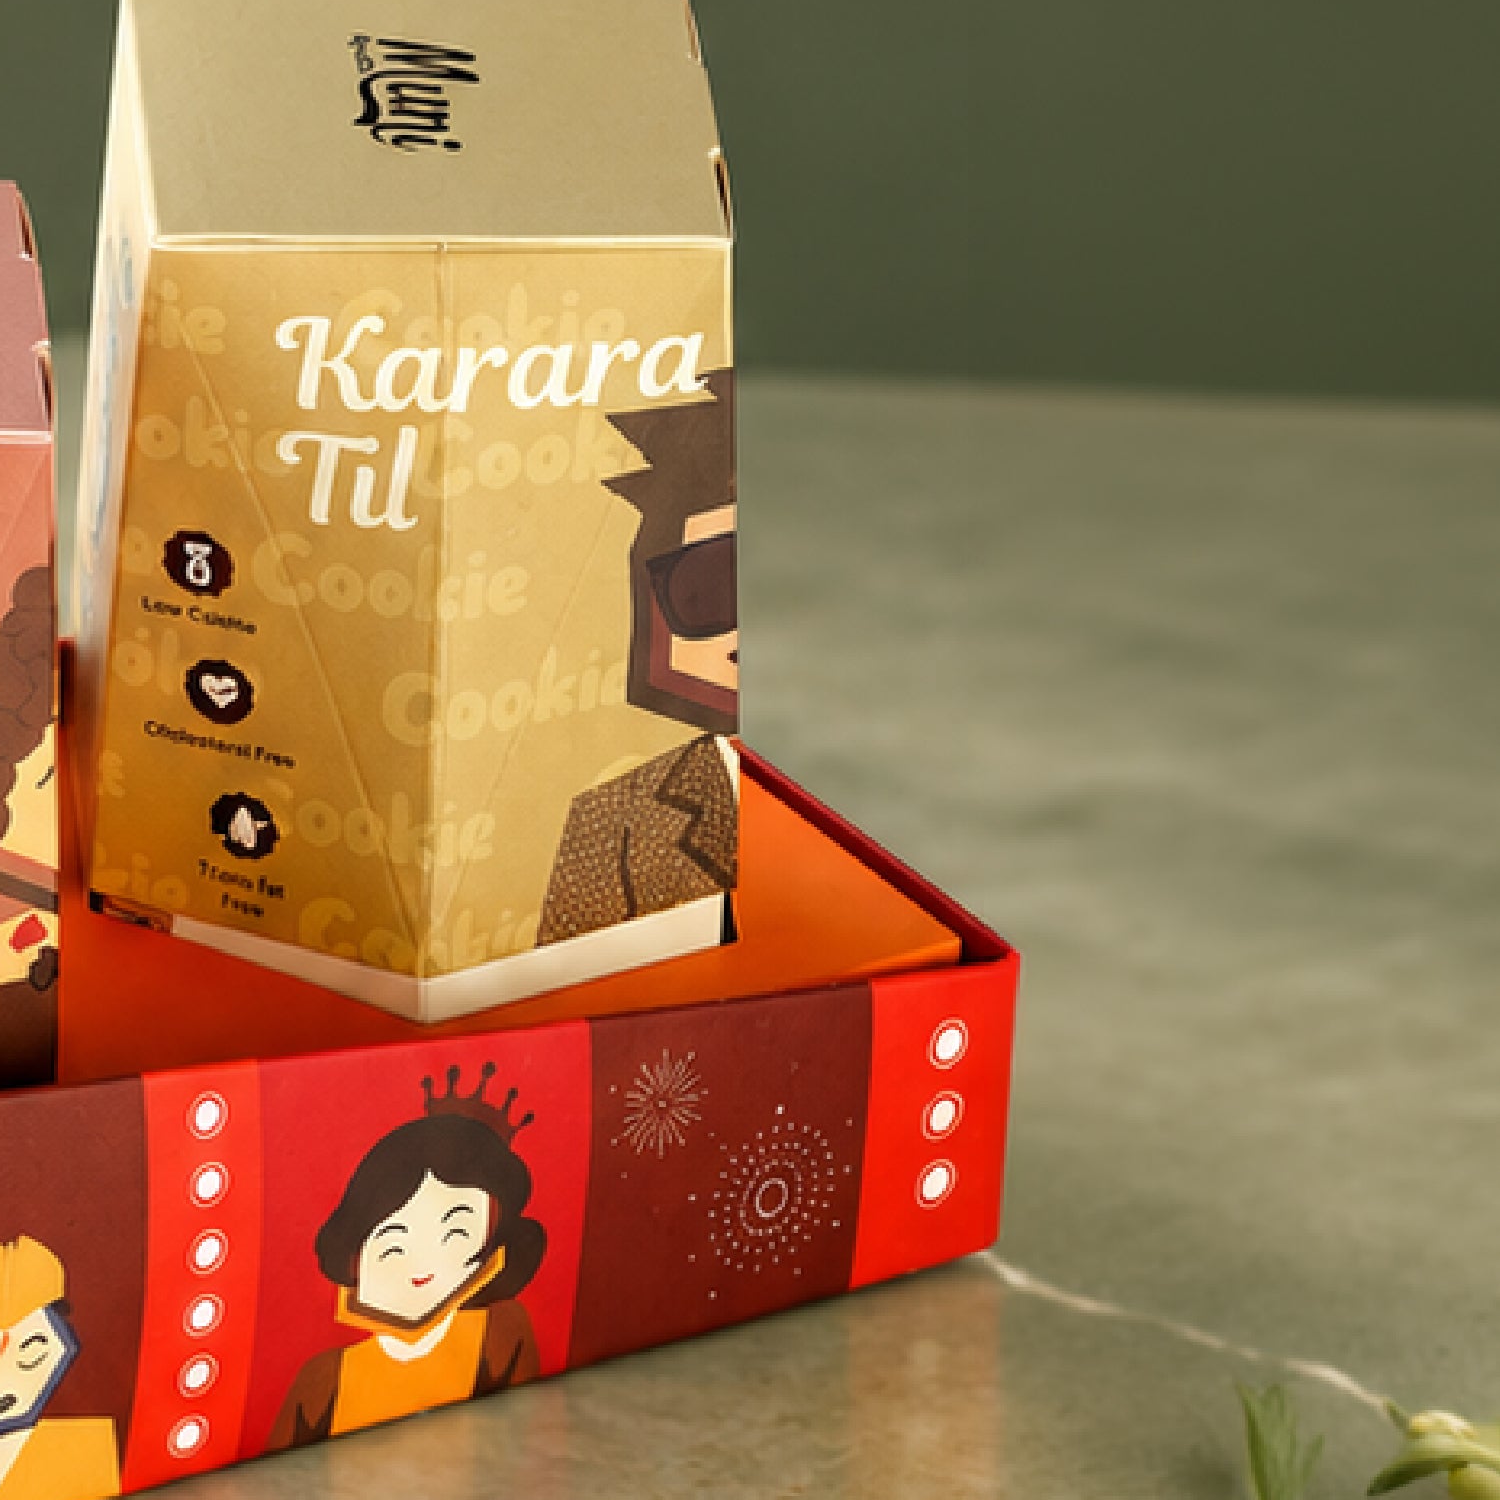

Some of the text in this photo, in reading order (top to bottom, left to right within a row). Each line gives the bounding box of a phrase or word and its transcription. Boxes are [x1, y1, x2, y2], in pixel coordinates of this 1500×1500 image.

[354, 37, 480, 153] Muni
[275, 315, 709, 414] Karara
[275, 425, 419, 531] Til
